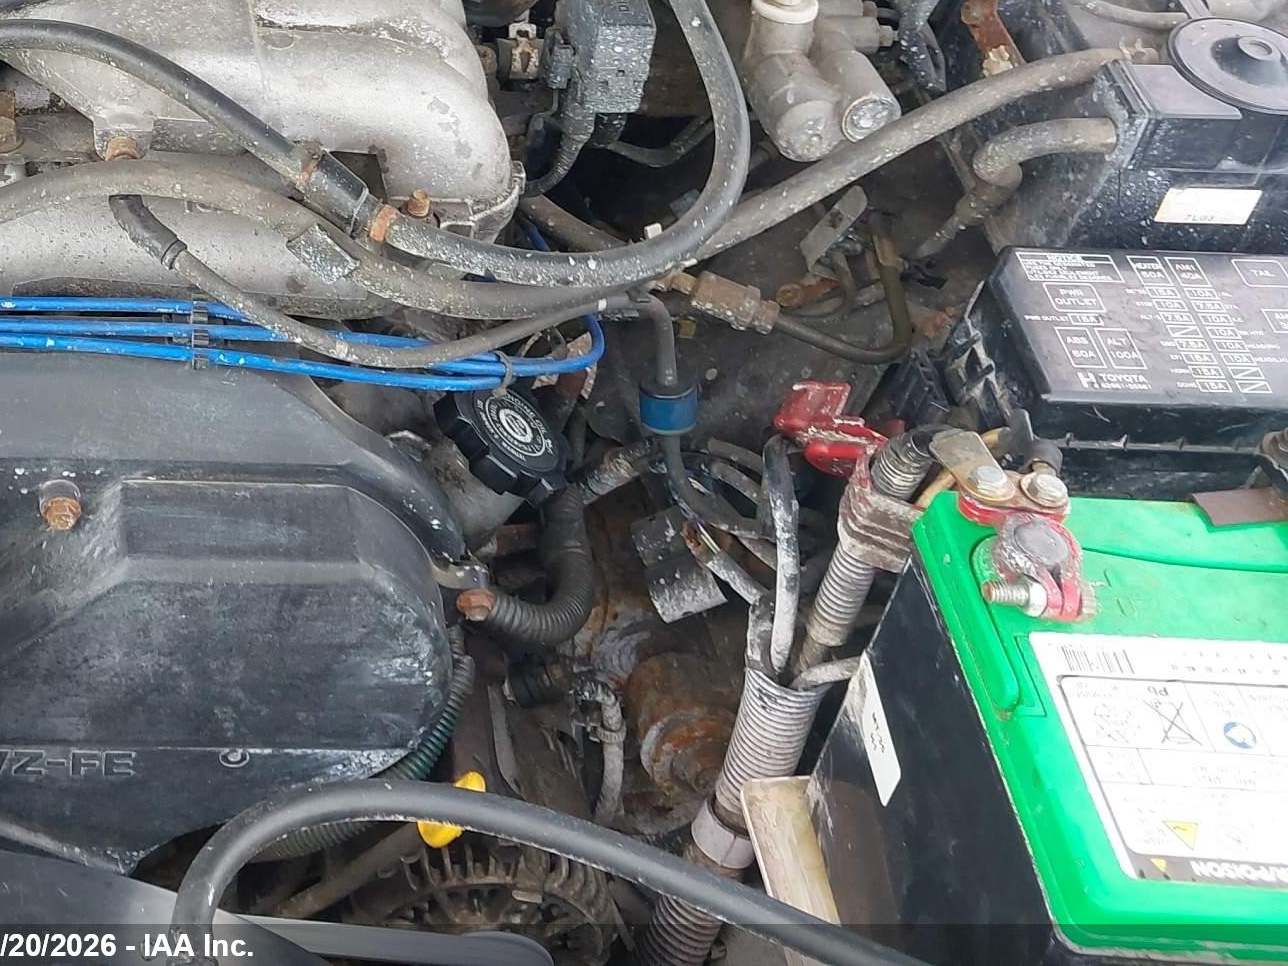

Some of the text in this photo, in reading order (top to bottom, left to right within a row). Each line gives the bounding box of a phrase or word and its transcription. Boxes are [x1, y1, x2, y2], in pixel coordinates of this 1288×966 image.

[1059, 288, 1084, 296] PWR
[1054, 298, 1097, 306] OUTLET
[1066, 336, 1089, 345] ABS
[1106, 337, 1127, 346] ALT
[1110, 351, 1139, 359] 100A
[1099, 373, 1149, 383] TOYOTA
